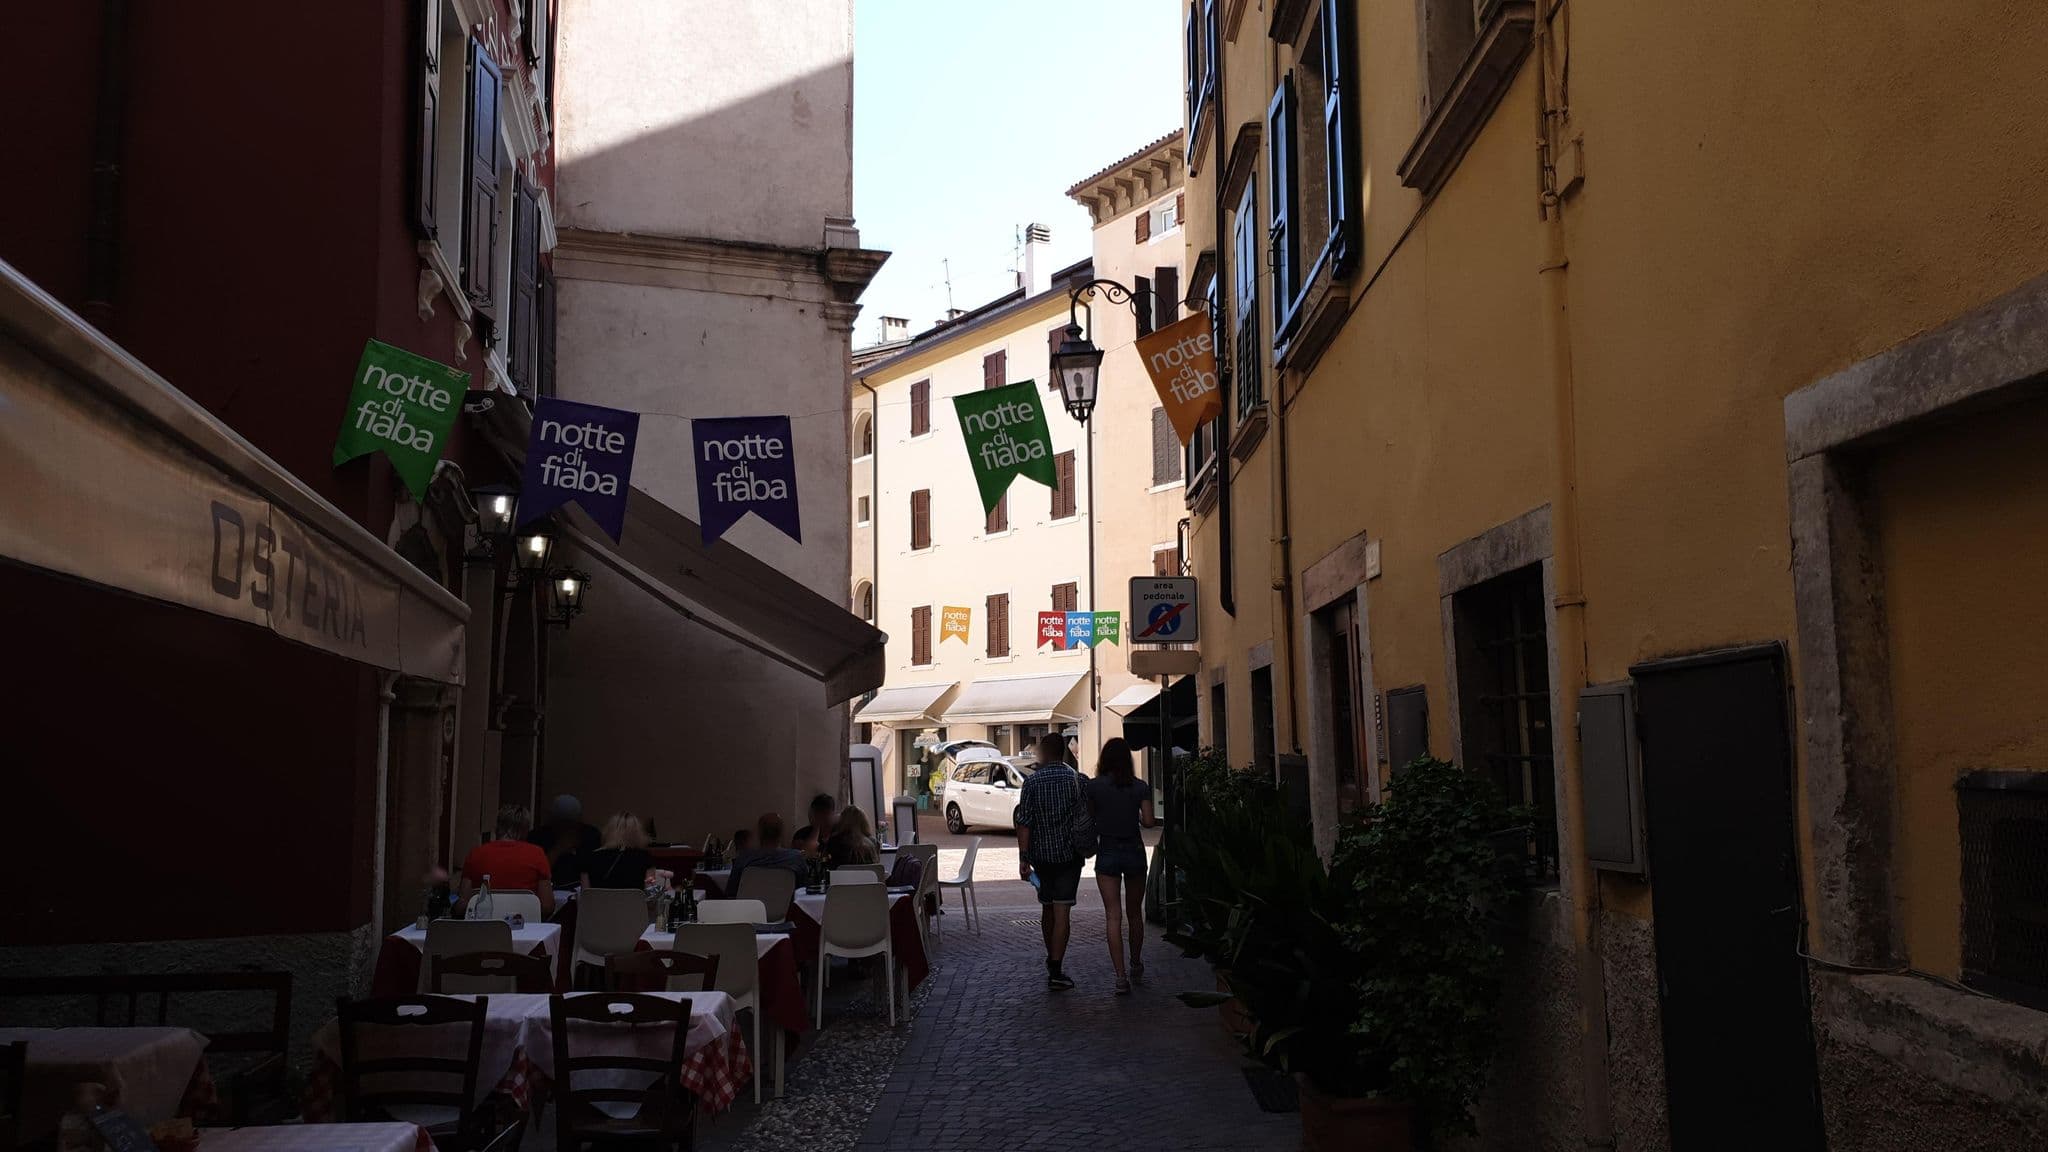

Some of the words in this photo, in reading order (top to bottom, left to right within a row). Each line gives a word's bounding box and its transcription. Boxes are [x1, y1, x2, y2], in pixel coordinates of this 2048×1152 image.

[1151, 333, 1213, 373] notte
[1180, 362, 1194, 379] di
[363, 365, 450, 412] notte
[1170, 369, 1218, 404] fiab
[383, 397, 404, 416] di
[964, 401, 1034, 435] notte
[356, 400, 434, 453] fiaba
[540, 420, 625, 453] notte
[993, 428, 1008, 446] di
[564, 448, 583, 467] di
[703, 434, 784, 461] notte
[979, 437, 1046, 470] fiaba
[540, 455, 618, 496] fiaba
[732, 460, 748, 478] di
[712, 471, 788, 502] fiaba
[211, 500, 367, 649] OSTERIA
[1143, 592, 1185, 600] pedonale
[1040, 616, 1064, 625] notte
[1068, 616, 1091, 625] notte
[1095, 616, 1117, 624] notte
[1042, 627, 1063, 637] fiaba
[1070, 627, 1090, 637] fiaba
